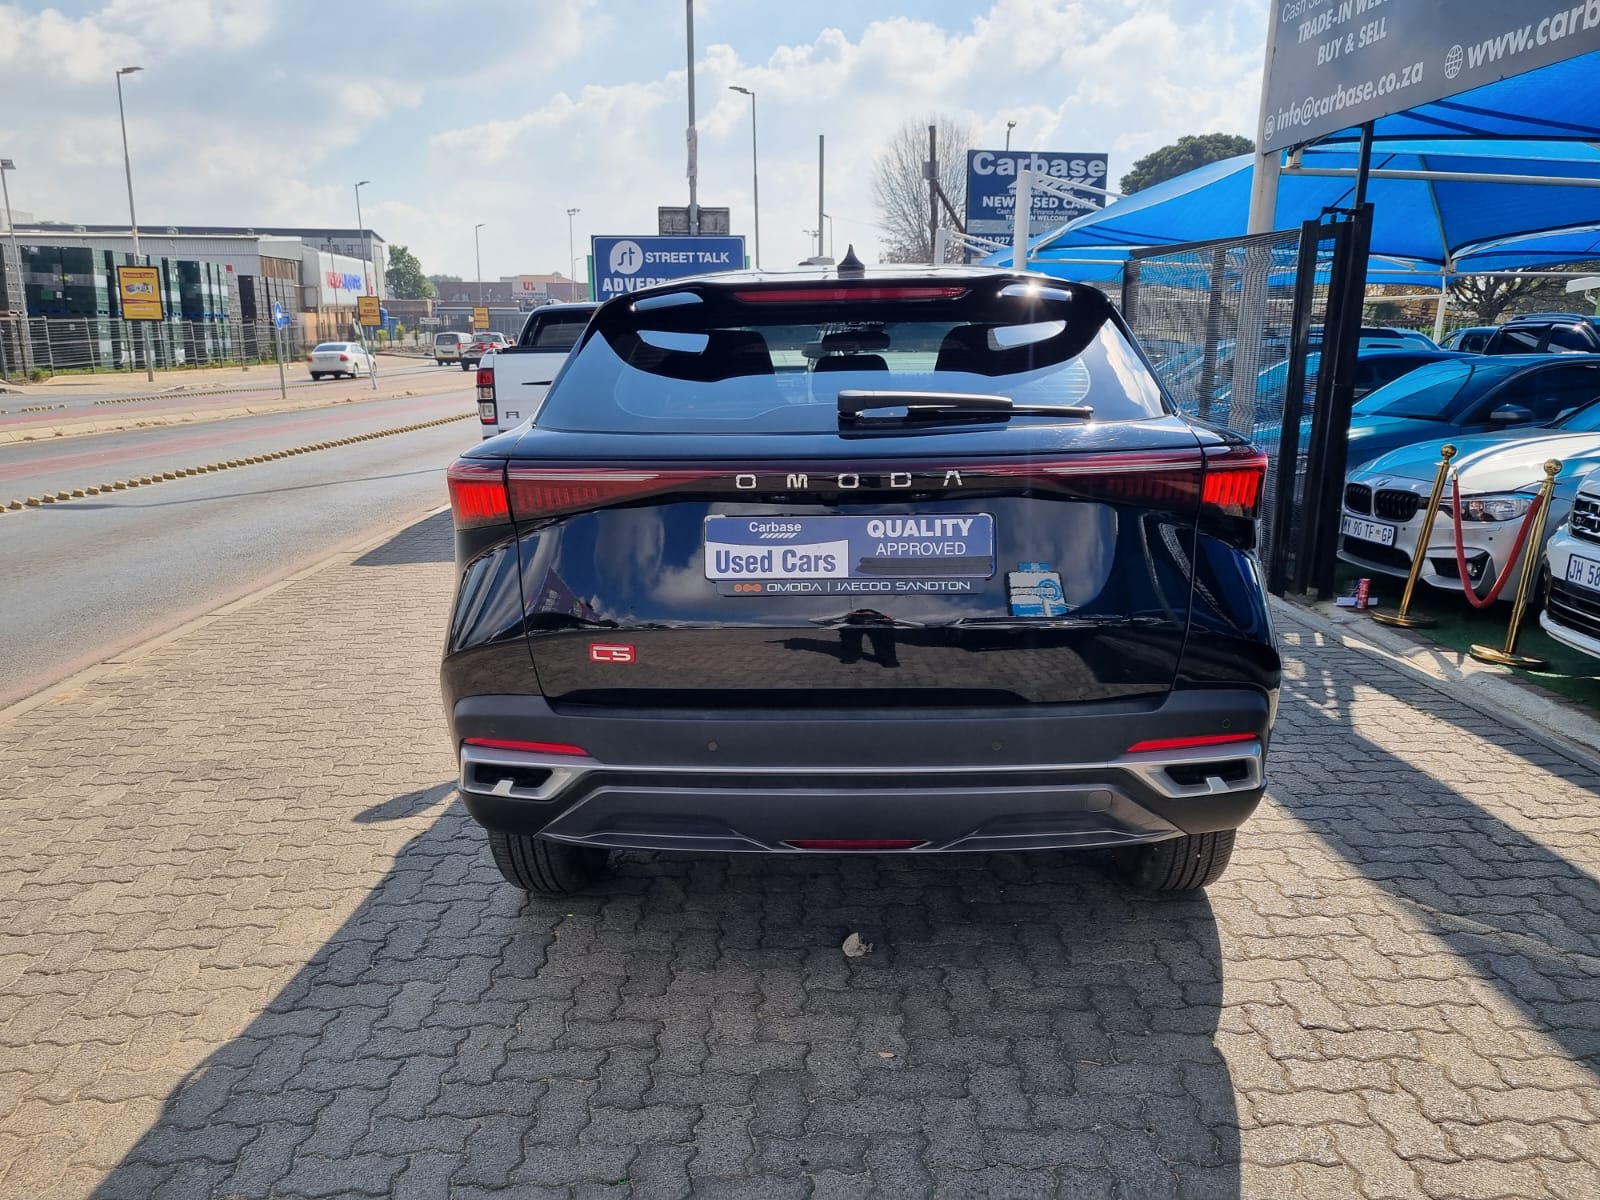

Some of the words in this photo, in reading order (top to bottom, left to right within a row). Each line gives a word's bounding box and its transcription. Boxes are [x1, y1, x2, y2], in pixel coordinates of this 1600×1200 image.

[1298, 0, 1353, 44] TRADE-IN
[1317, 36, 1343, 66] BUY
[1345, 32, 1355, 54] &
[1358, 16, 1387, 48] SELL
[1277, 61, 1424, 126] info@carbase.co.za
[972, 151, 1106, 177] Carbase
[982, 195, 1015, 208] NEW
[645, 252, 695, 263] STREET
[697, 252, 729, 263] TALK
[735, 470, 963, 489] OMODA
[749, 521, 802, 533] Carbase
[866, 518, 974, 538] QUALITY
[1381, 527, 1393, 543] GP
[876, 542, 966, 556] APPROVED
[715, 549, 773, 573] Used
[781, 549, 836, 573] Cars
[1569, 559, 1584, 581] JH
[766, 582, 822, 592] OMODA
[895, 581, 971, 591] SANDTON
